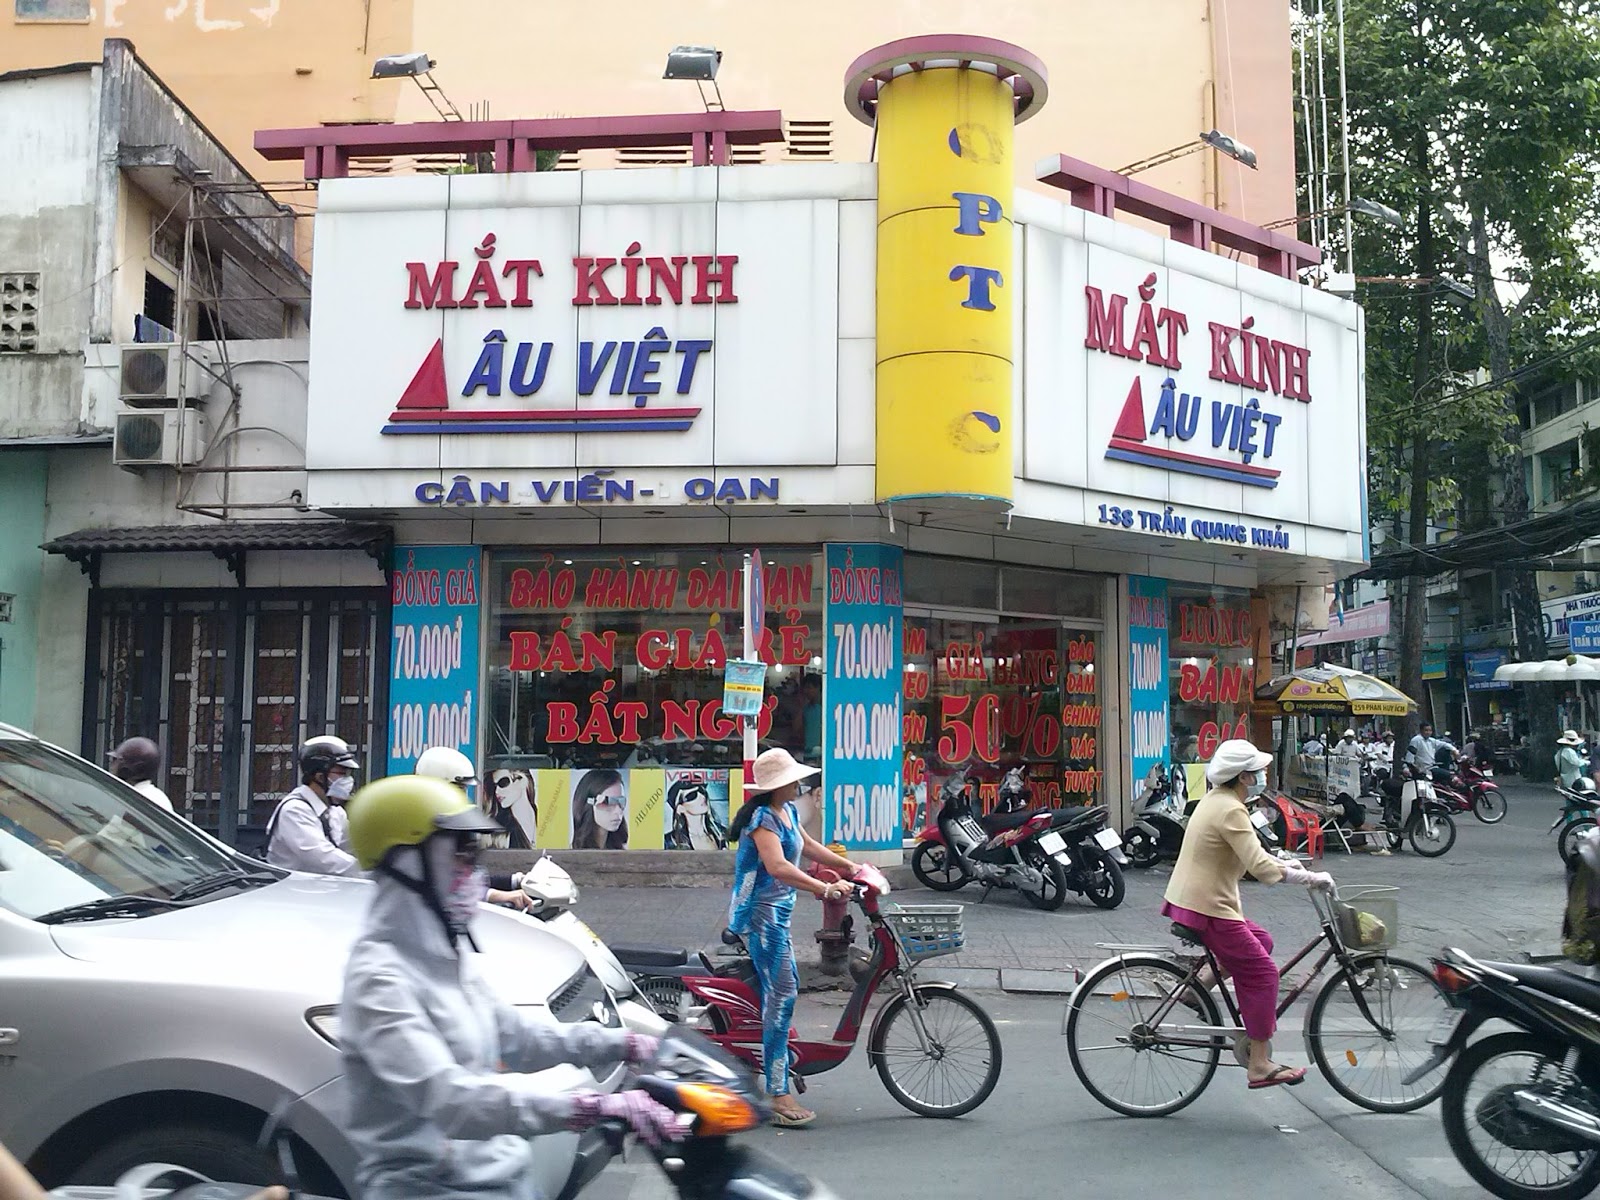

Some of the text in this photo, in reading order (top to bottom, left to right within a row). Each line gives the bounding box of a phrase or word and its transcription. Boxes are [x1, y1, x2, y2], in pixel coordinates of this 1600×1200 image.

[404, 232, 739, 310] MẮT KÍNH
[462, 326, 713, 407] ÂU VIỆT
[1084, 272, 1312, 403] MẮT KÍNH
[1150, 377, 1282, 464] ÂU VIỆT
[415, 475, 510, 507] CẬN
[1098, 503, 1290, 549] 138 TRẦN QUANG KHẢI
[393, 551, 478, 607] ĐỒNG GIÁ
[510, 553, 813, 613] BẢO HÀNH DÀI ẠN
[830, 547, 881, 605] ĐỒNG
[395, 615, 462, 679] 70.000đ
[509, 617, 617, 672] BÁN
[636, 612, 728, 671] GIÁ
[834, 616, 894, 679] 70.000đ
[1069, 634, 1095, 663] BẢO
[1180, 655, 1242, 704] BÁN
[546, 680, 649, 744] BẤT
[834, 692, 899, 760] 100.000đ
[1062, 701, 1101, 727] CHÍNH
[1070, 733, 1096, 760] XÁC
[666, 770, 729, 784] VOGUE
[834, 771, 899, 842] 150.000đ
[1065, 766, 1103, 796] TUYỆT
